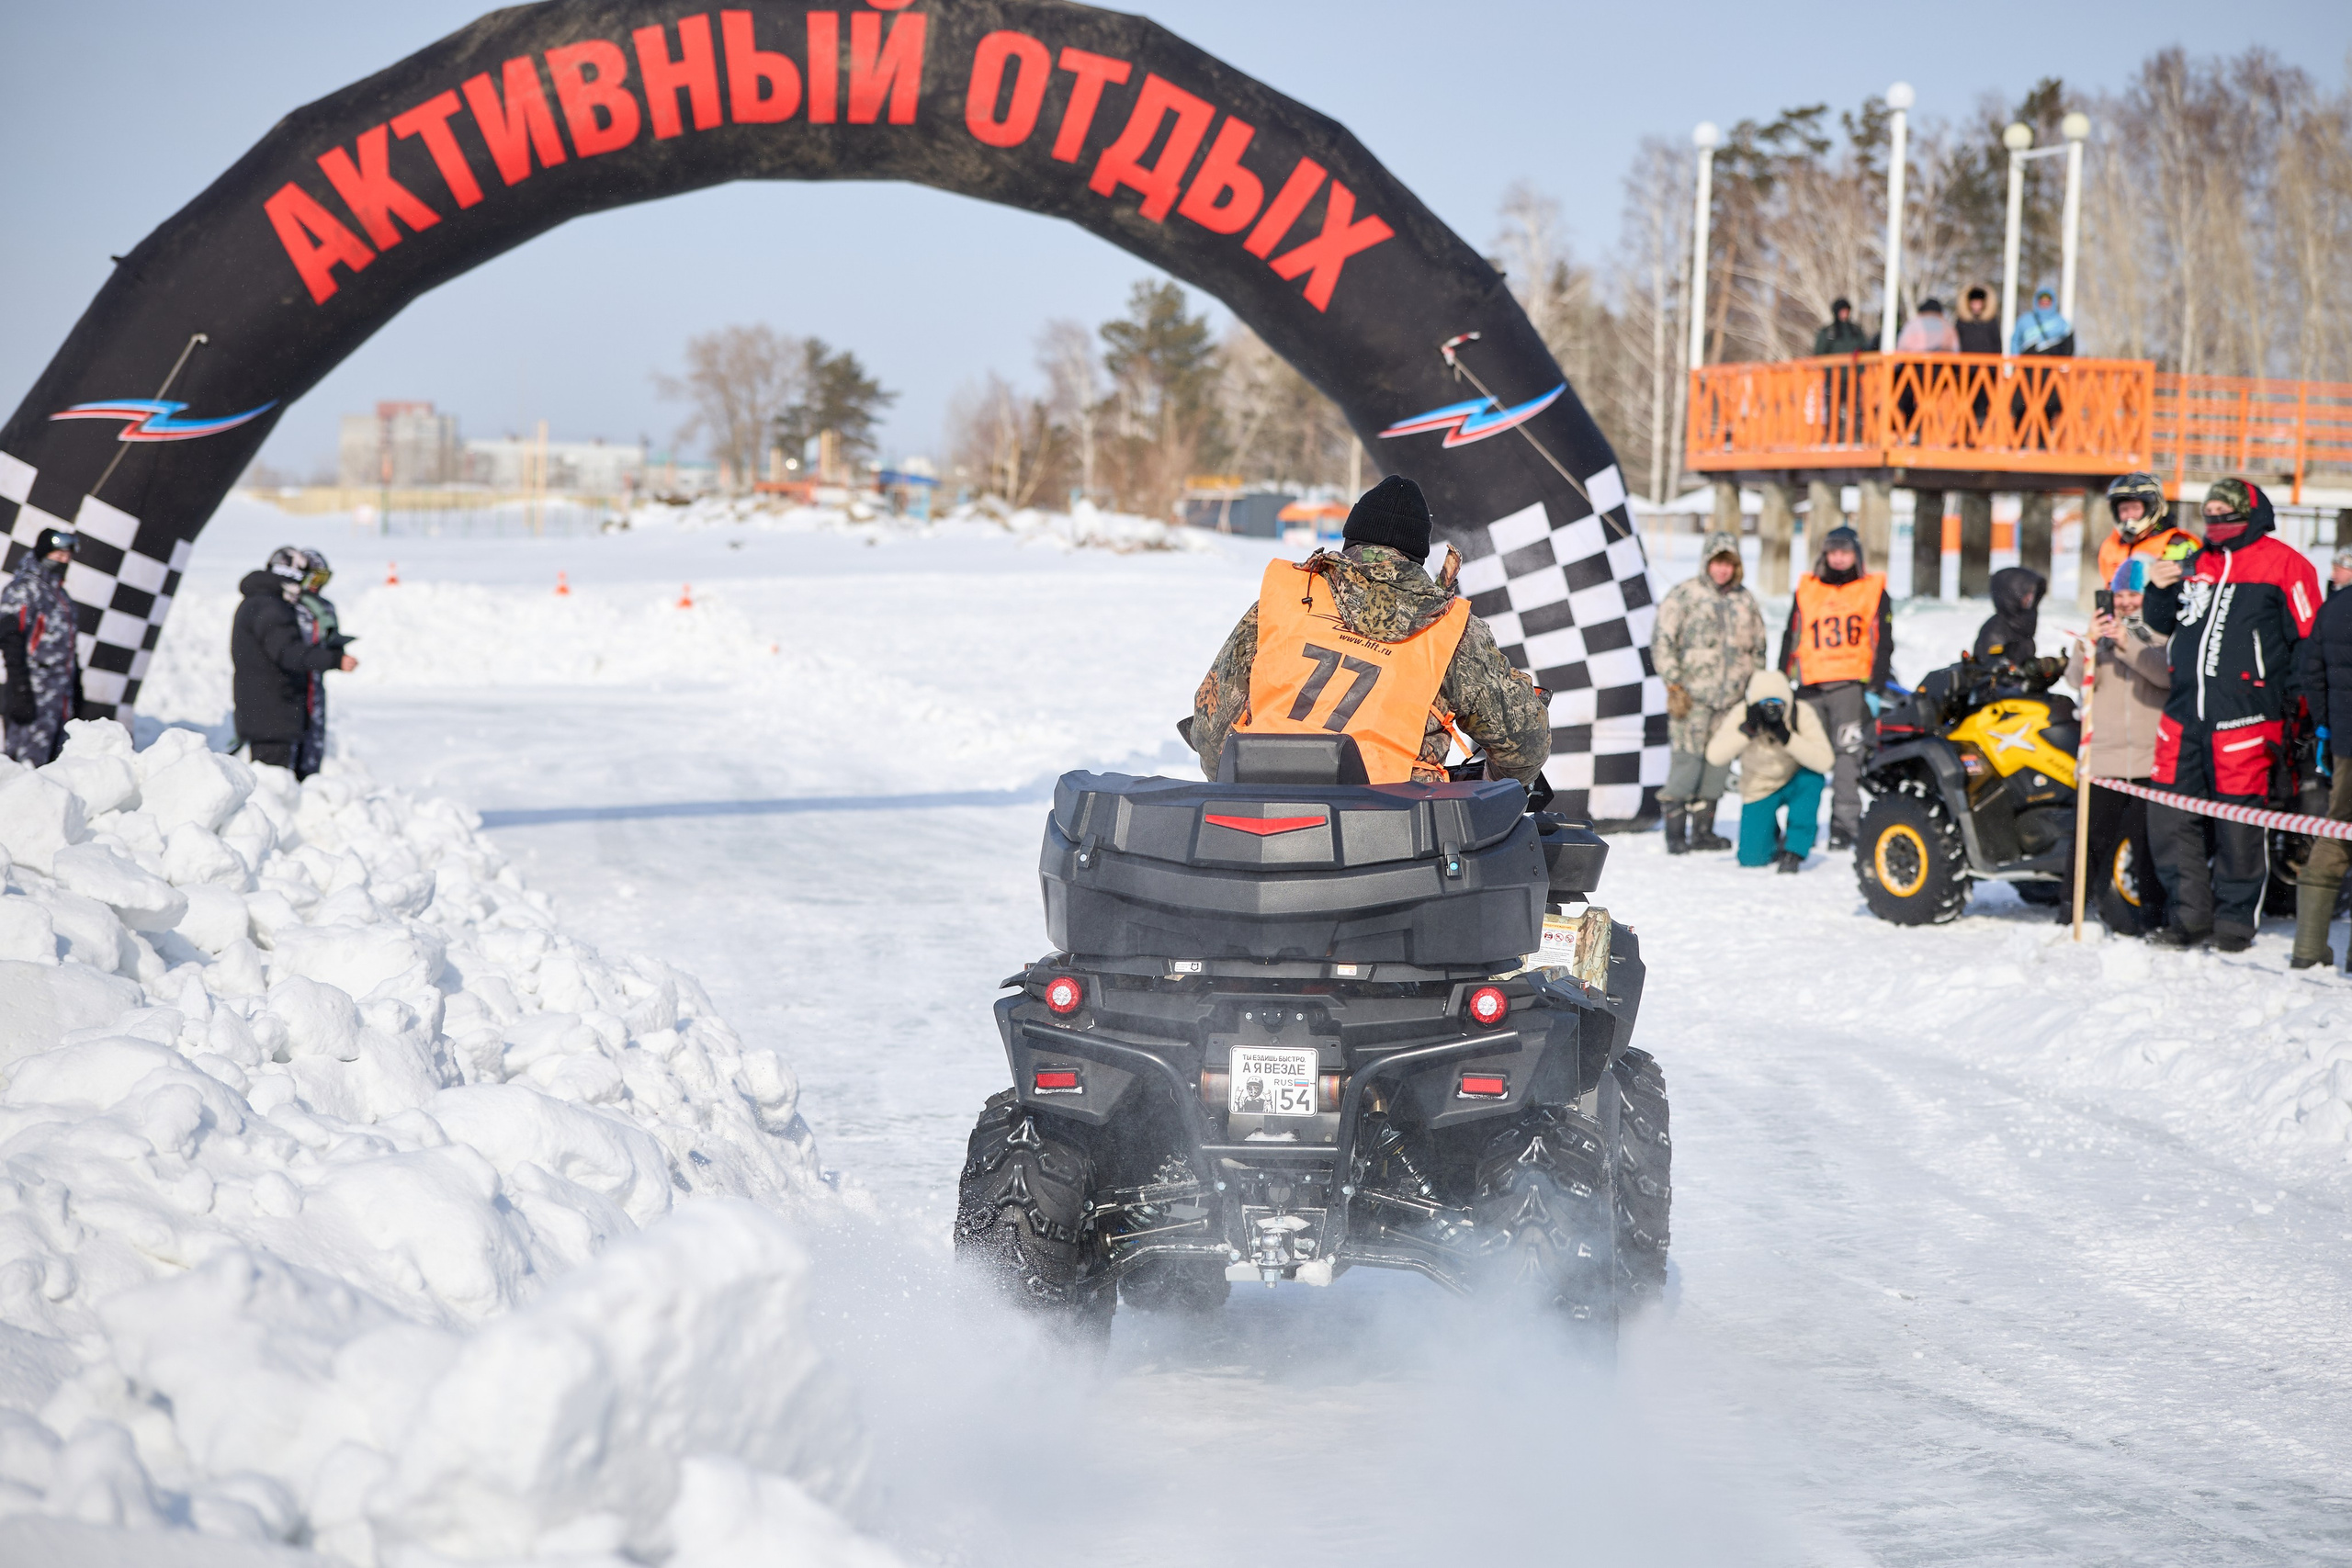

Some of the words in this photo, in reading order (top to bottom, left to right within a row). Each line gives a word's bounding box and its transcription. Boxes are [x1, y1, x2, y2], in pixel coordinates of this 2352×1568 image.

[264, 0, 929, 304] АКТИВНЫЙ
[965, 29, 1395, 312] ОТДЫХ
[1339, 634, 1392, 657] www.hft.ru
[1811, 615, 1862, 649] 136
[2205, 582, 2236, 677] FINNTRAIL
[1287, 642, 1382, 733] 77
[1242, 1062, 1251, 1074] А
[1253, 1062, 1262, 1074] Я
[1264, 1063, 1306, 1075] ВЕЗДЕ
[1280, 1089, 1310, 1111] 54
